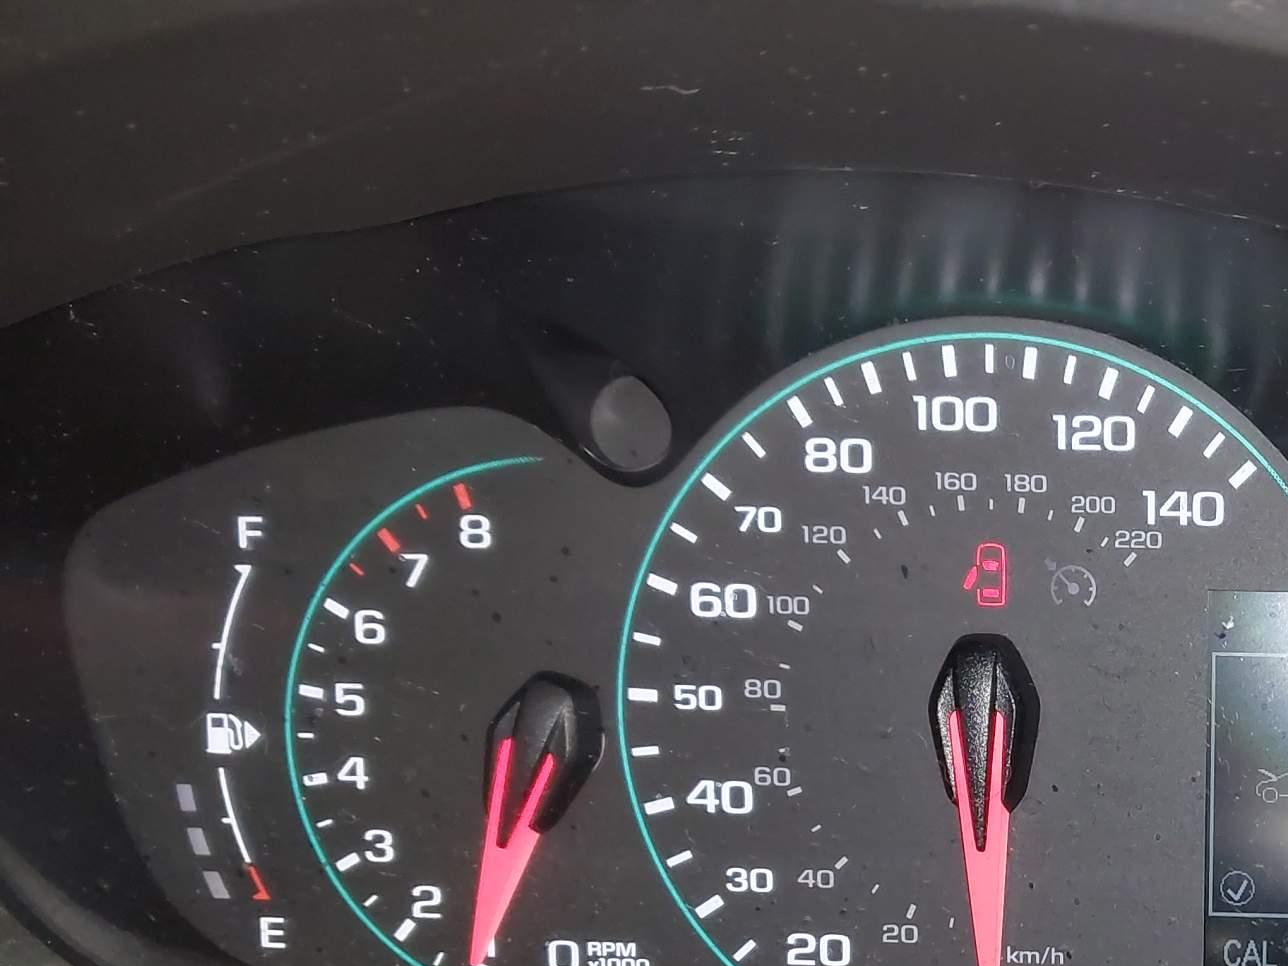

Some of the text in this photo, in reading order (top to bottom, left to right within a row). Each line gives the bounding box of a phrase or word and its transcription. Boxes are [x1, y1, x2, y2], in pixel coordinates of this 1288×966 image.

[912, 395, 997, 432] 100
[1053, 414, 1135, 452] 120
[804, 438, 872, 473] 80
[935, 472, 977, 491] 160
[1005, 474, 1048, 493] 180
[863, 486, 906, 506] 140
[1071, 496, 1115, 515] 200
[1142, 490, 1224, 527] 140
[237, 515, 262, 548] F
[459, 514, 492, 549] 8
[734, 506, 782, 532] 70
[801, 526, 846, 545] 120
[1115, 530, 1162, 550] 220
[401, 554, 429, 587] 7
[690, 583, 756, 618] 60
[767, 596, 809, 615] 100
[355, 610, 385, 643] 6
[335, 683, 366, 716] 5
[673, 686, 722, 711] 50
[744, 679, 781, 699] 80
[337, 757, 368, 789] 4
[754, 767, 791, 787] 60
[686, 779, 754, 815] 40
[364, 830, 394, 862] 3
[726, 868, 773, 893] 30
[797, 870, 834, 889] 40
[412, 886, 441, 918] 2
[260, 918, 286, 948] E
[882, 925, 918, 944] 20
[587, 942, 636, 957] RPM
[786, 933, 851, 966] 20
[1007, 946, 1064, 965] km/h
